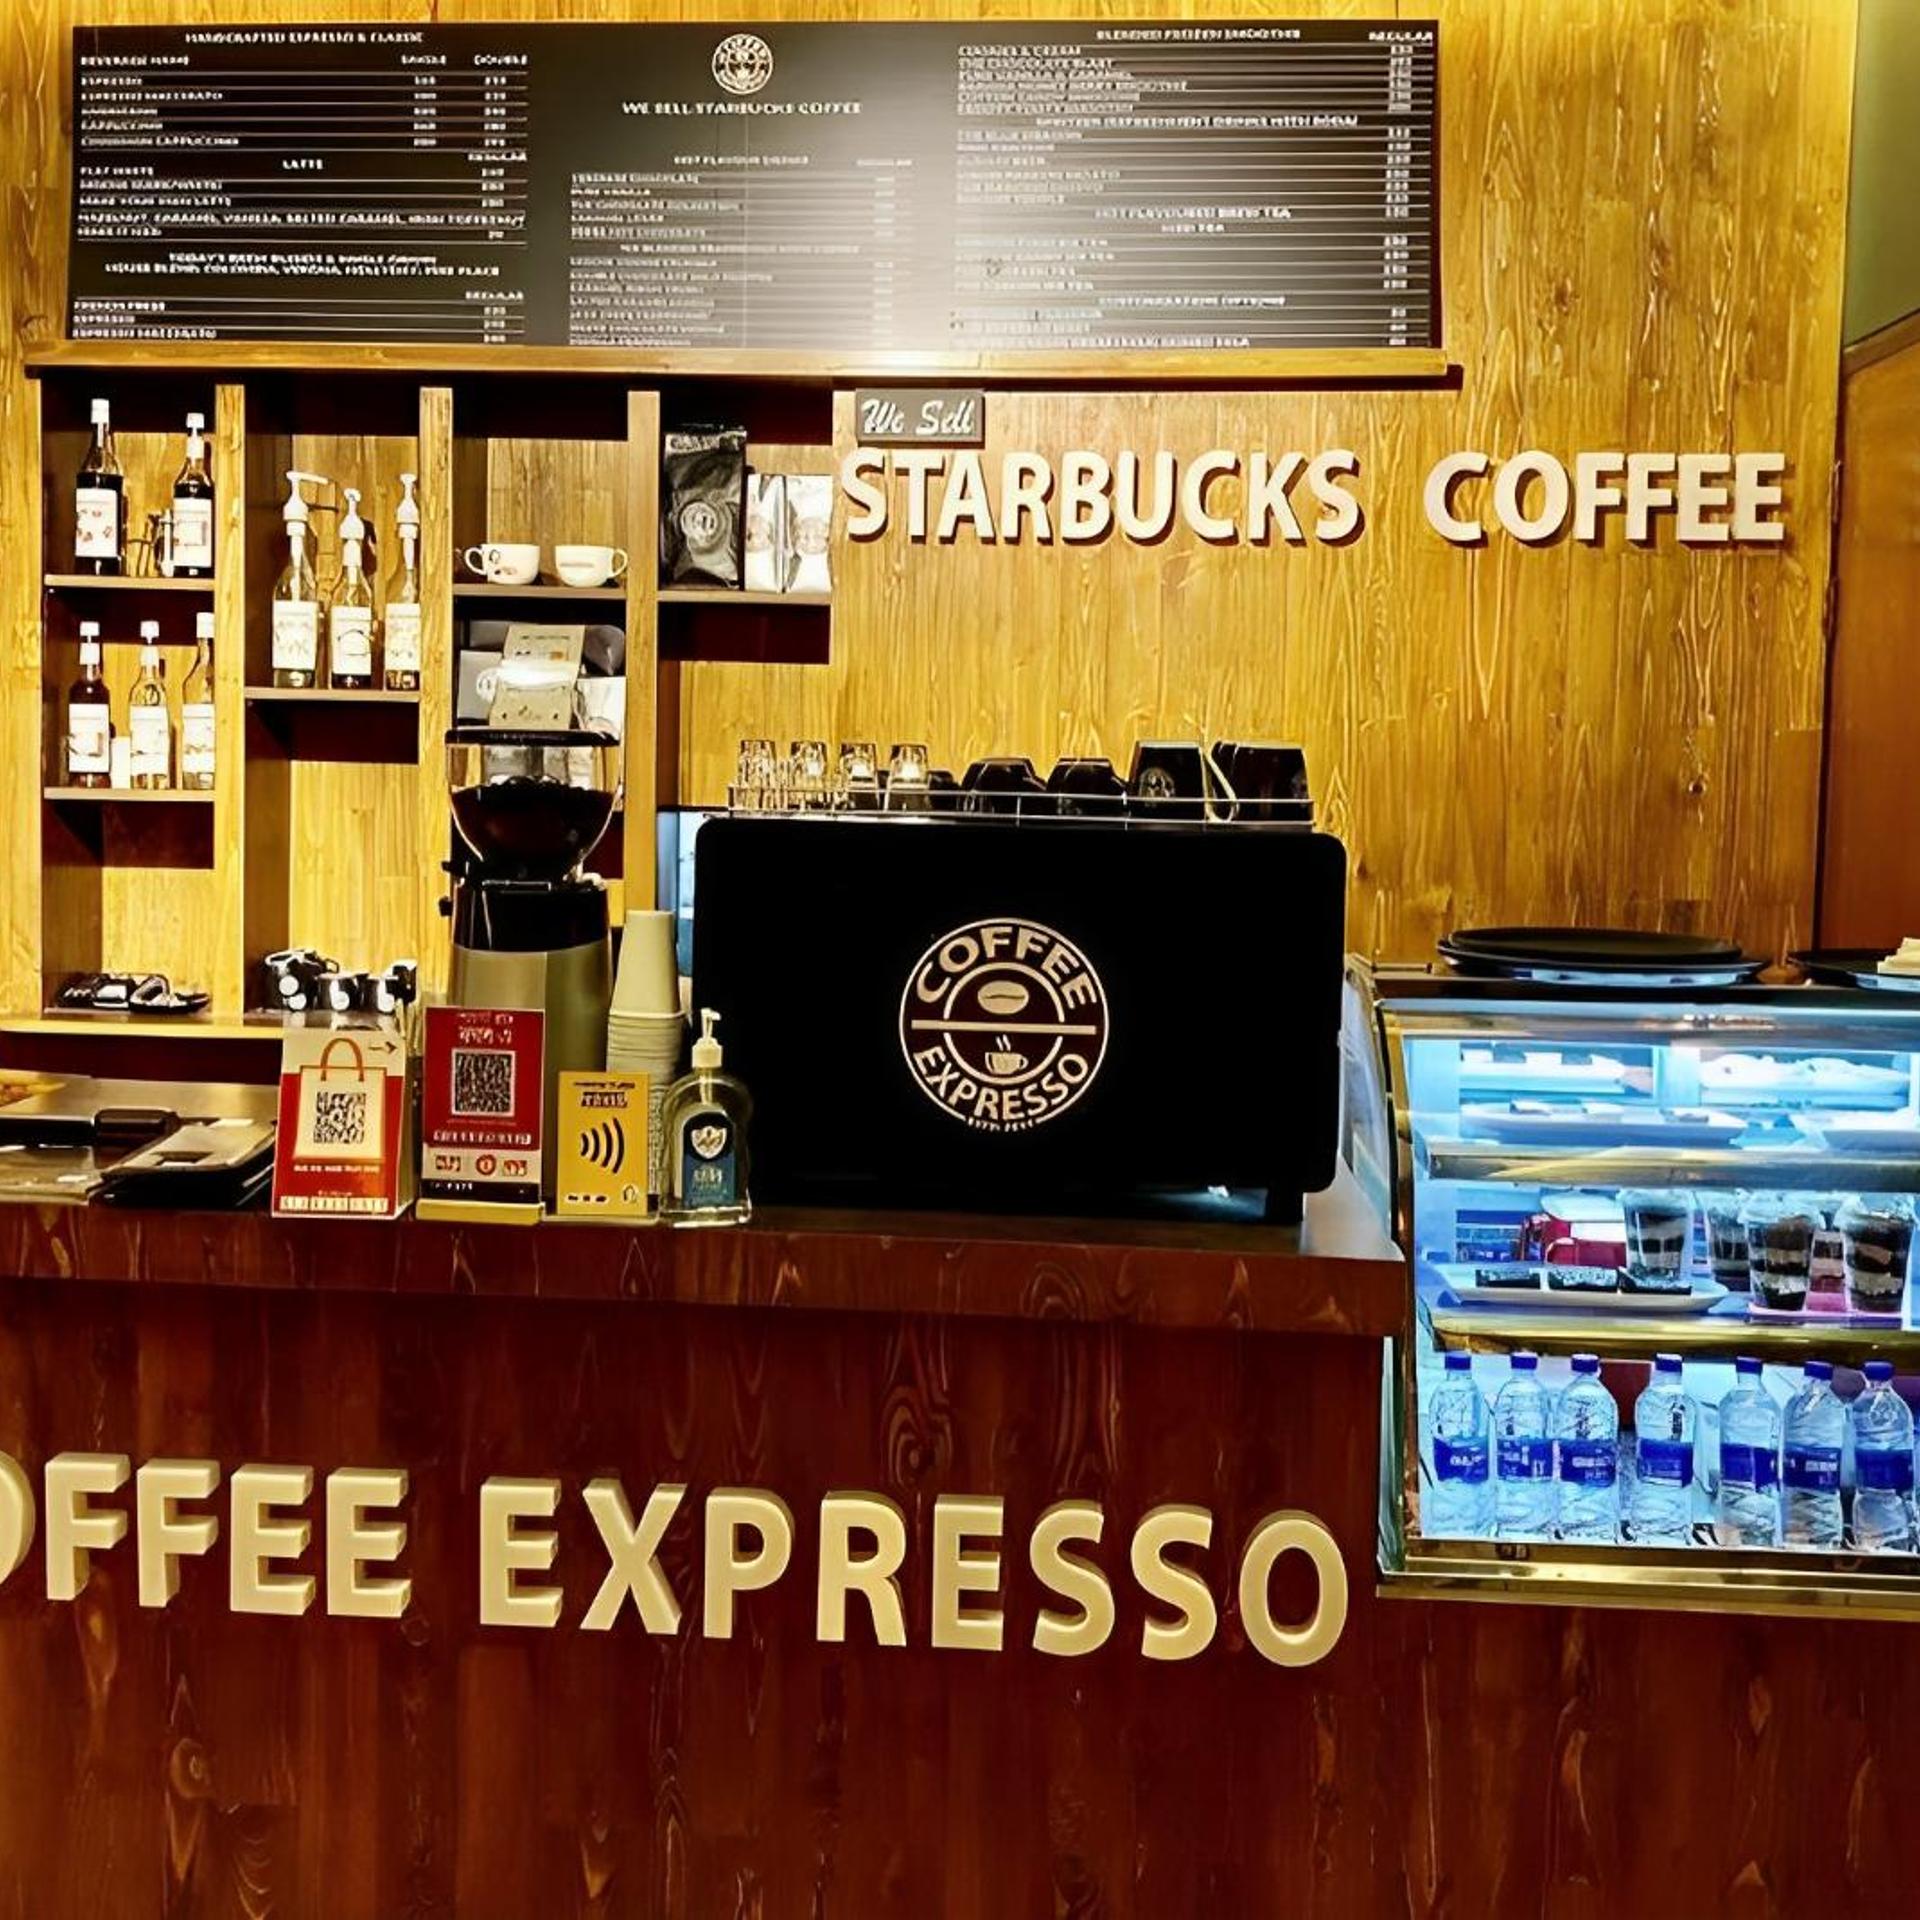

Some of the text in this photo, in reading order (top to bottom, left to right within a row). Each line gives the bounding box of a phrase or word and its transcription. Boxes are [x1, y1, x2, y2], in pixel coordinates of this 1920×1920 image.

[798, 101, 862, 114] COFFEE
[282, 159, 323, 170] LATTE
[860, 396, 975, 436] We Sell
[840, 447, 1786, 546] STARBUCKS COFFEE
[916, 926, 1098, 1010] COFFEE
[912, 1045, 1089, 1121] EXPRESSO
[479, 1477, 1349, 1668] EXPRESSO
